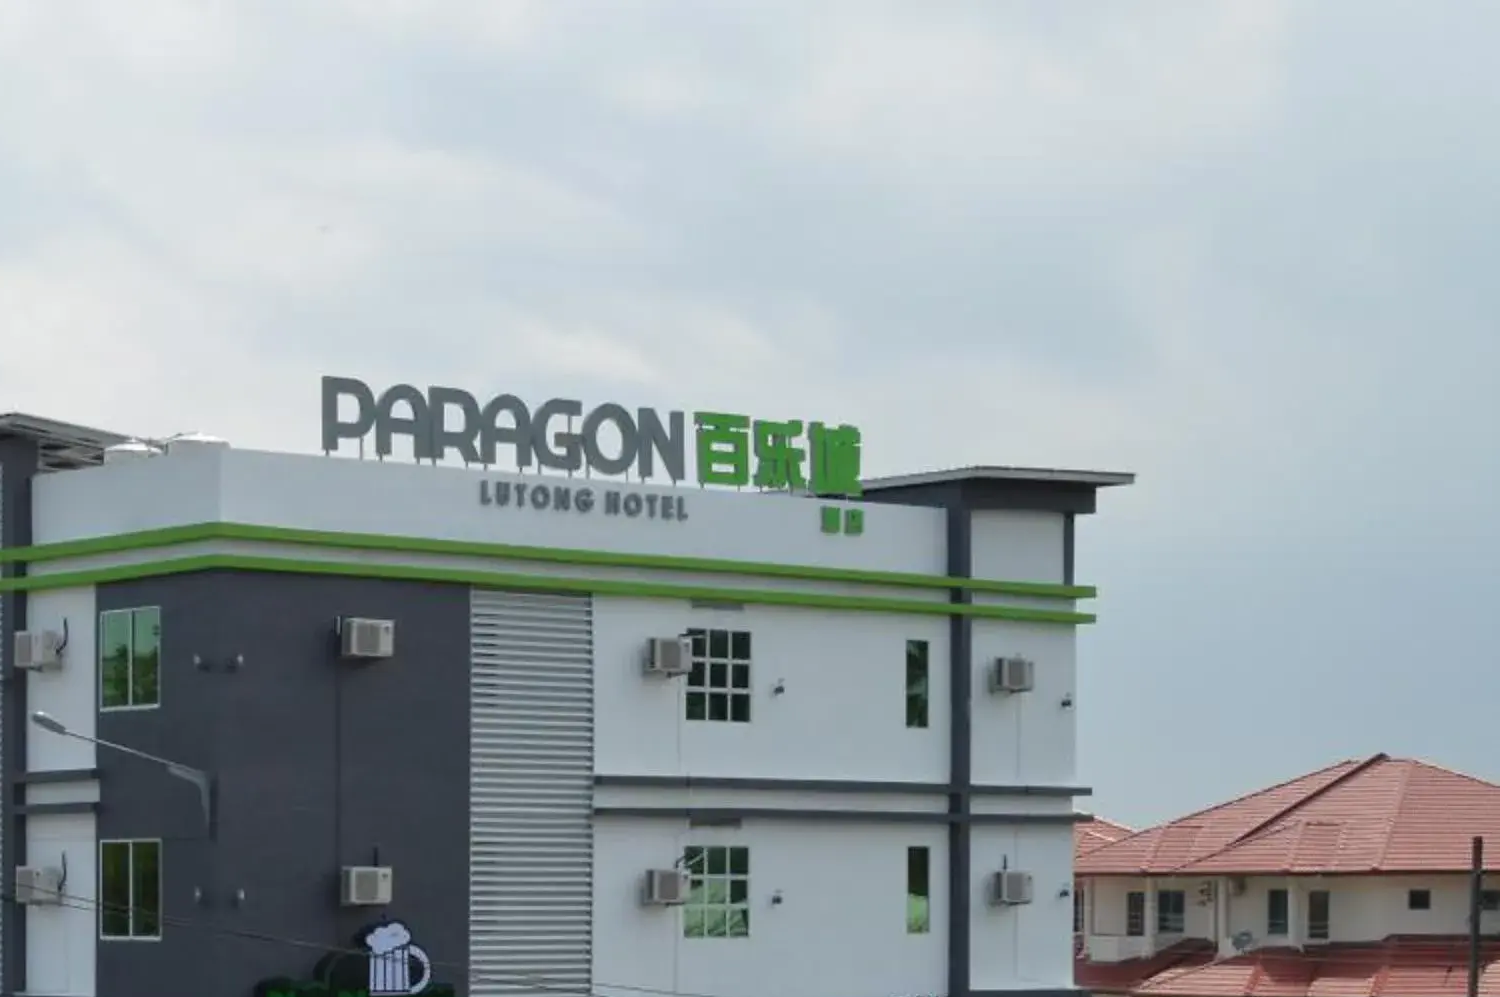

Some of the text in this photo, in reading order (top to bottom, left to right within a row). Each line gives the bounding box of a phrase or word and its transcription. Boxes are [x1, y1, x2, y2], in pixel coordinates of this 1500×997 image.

[320, 375, 684, 481] PARAGON
[479, 479, 689, 522] LUTONG HOTEL
